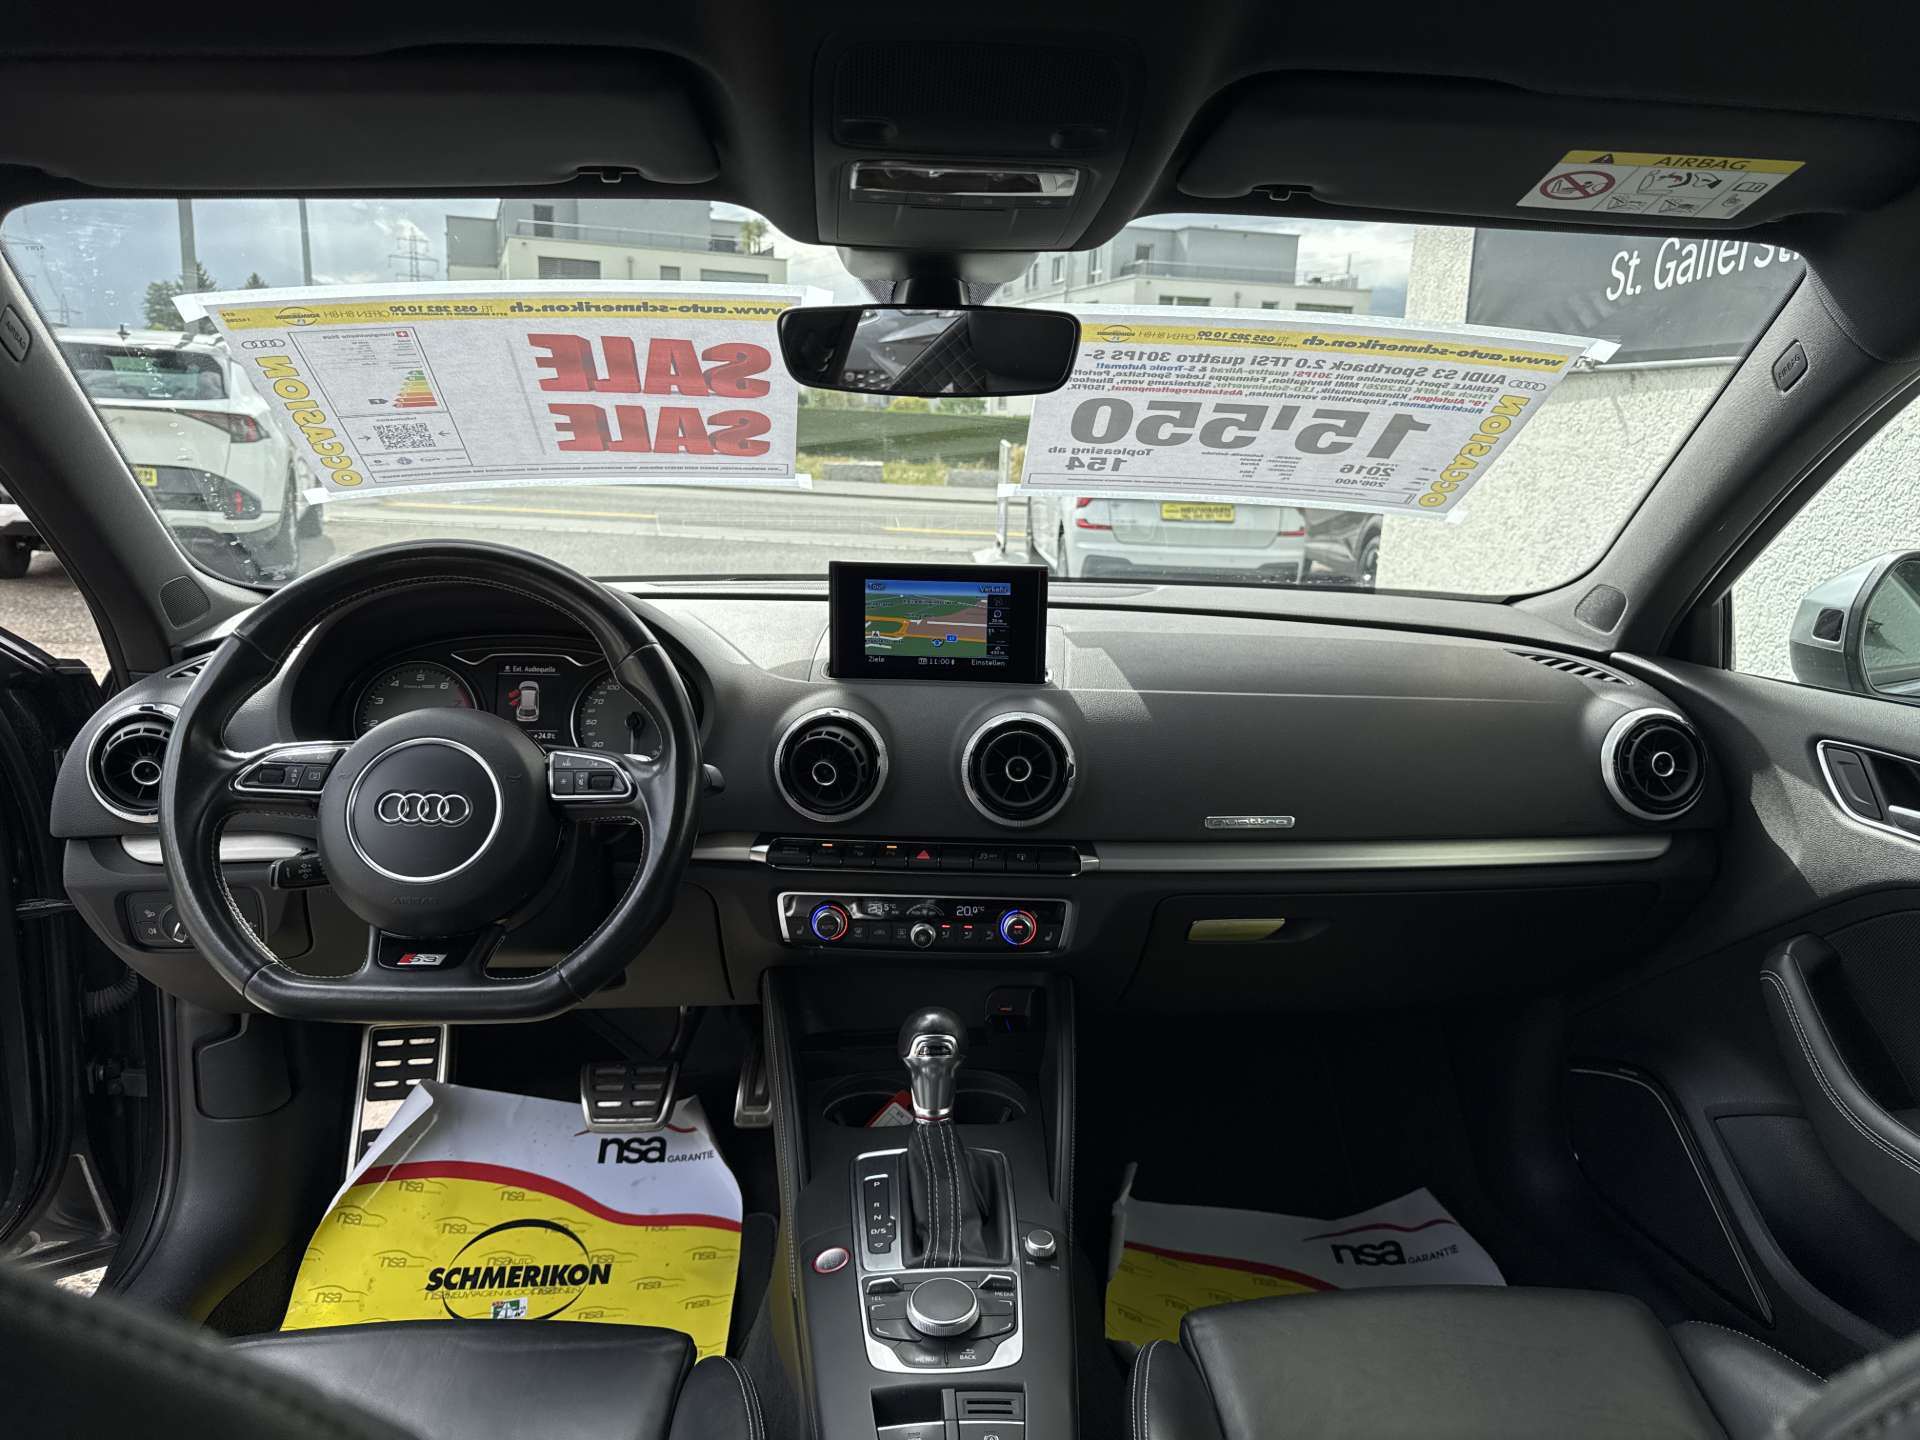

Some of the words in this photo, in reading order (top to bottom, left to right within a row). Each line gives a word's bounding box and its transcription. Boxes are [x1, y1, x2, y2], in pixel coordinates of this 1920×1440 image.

[1654, 157, 1750, 170] AIRBAG
[1606, 250, 1642, 300] St.
[416, 673, 425, 682] 5
[439, 682, 449, 690] 6
[374, 697, 384, 705] 3
[368, 719, 379, 727] 2
[592, 741, 604, 749] 30
[598, 1136, 667, 1164] nsa
[667, 1149, 715, 1163] GARANTIE
[500, 1189, 525, 1202] nsa
[336, 1210, 363, 1226] nsa
[873, 1213, 882, 1221] N
[440, 1222, 467, 1235] nsa
[870, 1227, 887, 1235] D/S
[692, 1248, 718, 1262] nsa
[1330, 1240, 1407, 1267] nsa
[1407, 1243, 1460, 1265] GARANTIE
[380, 1253, 408, 1268] nsa
[424, 1263, 612, 1291] SCHMERIKON
[636, 1278, 663, 1291] nsa
[316, 1290, 343, 1304] nsa
[578, 1307, 605, 1320] nsa
